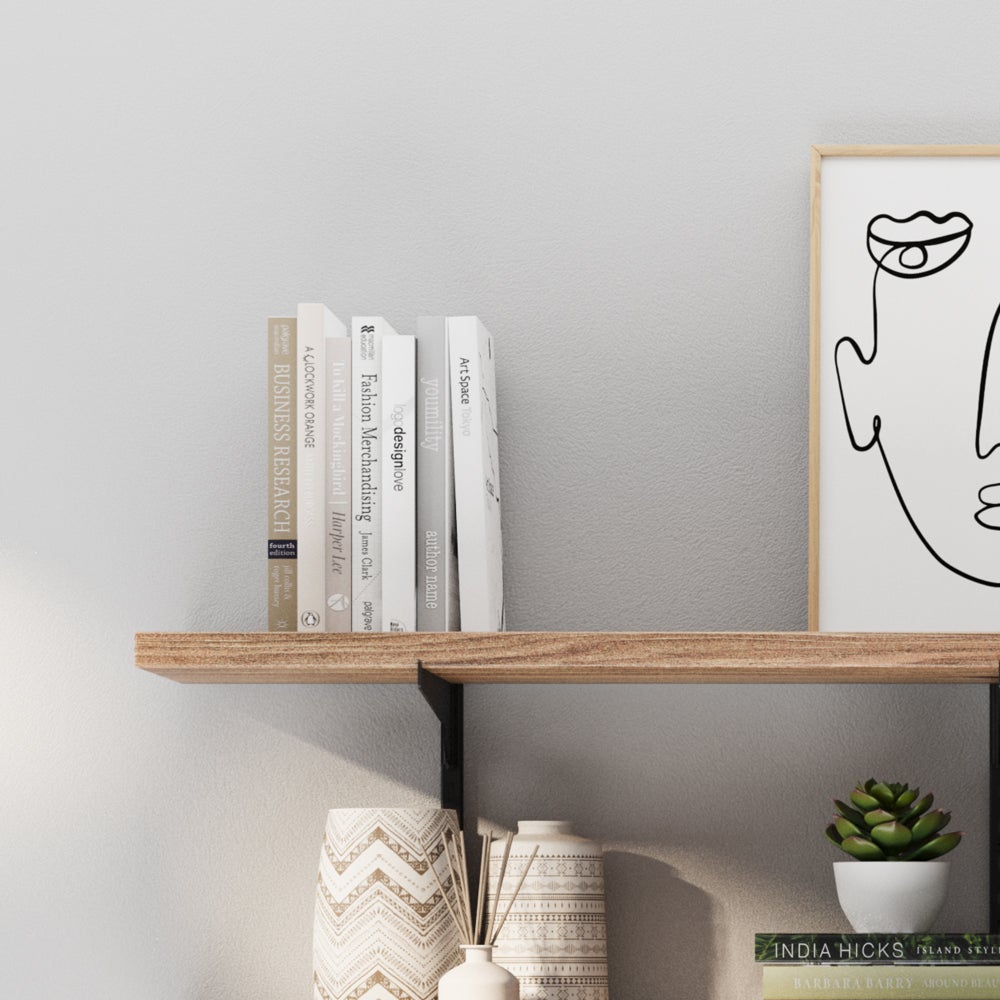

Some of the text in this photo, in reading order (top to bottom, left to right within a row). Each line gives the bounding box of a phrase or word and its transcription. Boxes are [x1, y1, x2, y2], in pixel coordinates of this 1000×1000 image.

[304, 354, 315, 410] CLOCKWORK
[458, 375, 471, 405] Space
[459, 357, 470, 375] Art
[304, 412, 315, 449] ORANGE
[420, 377, 442, 452] youmility
[273, 363, 291, 533] BUSINESS RESEARCH
[356, 373, 378, 522] Fashion Merchandising
[329, 511, 346, 575] Harper Lee
[359, 530, 373, 581] James Clark
[425, 530, 440, 609] author name
[362, 601, 374, 631] palgrave
[775, 942, 832, 958] INDIA
[839, 942, 904, 958] HICKS
[917, 946, 961, 954] ISLAND
[794, 977, 861, 990] BARBARA
[866, 977, 913, 989] BARRY
